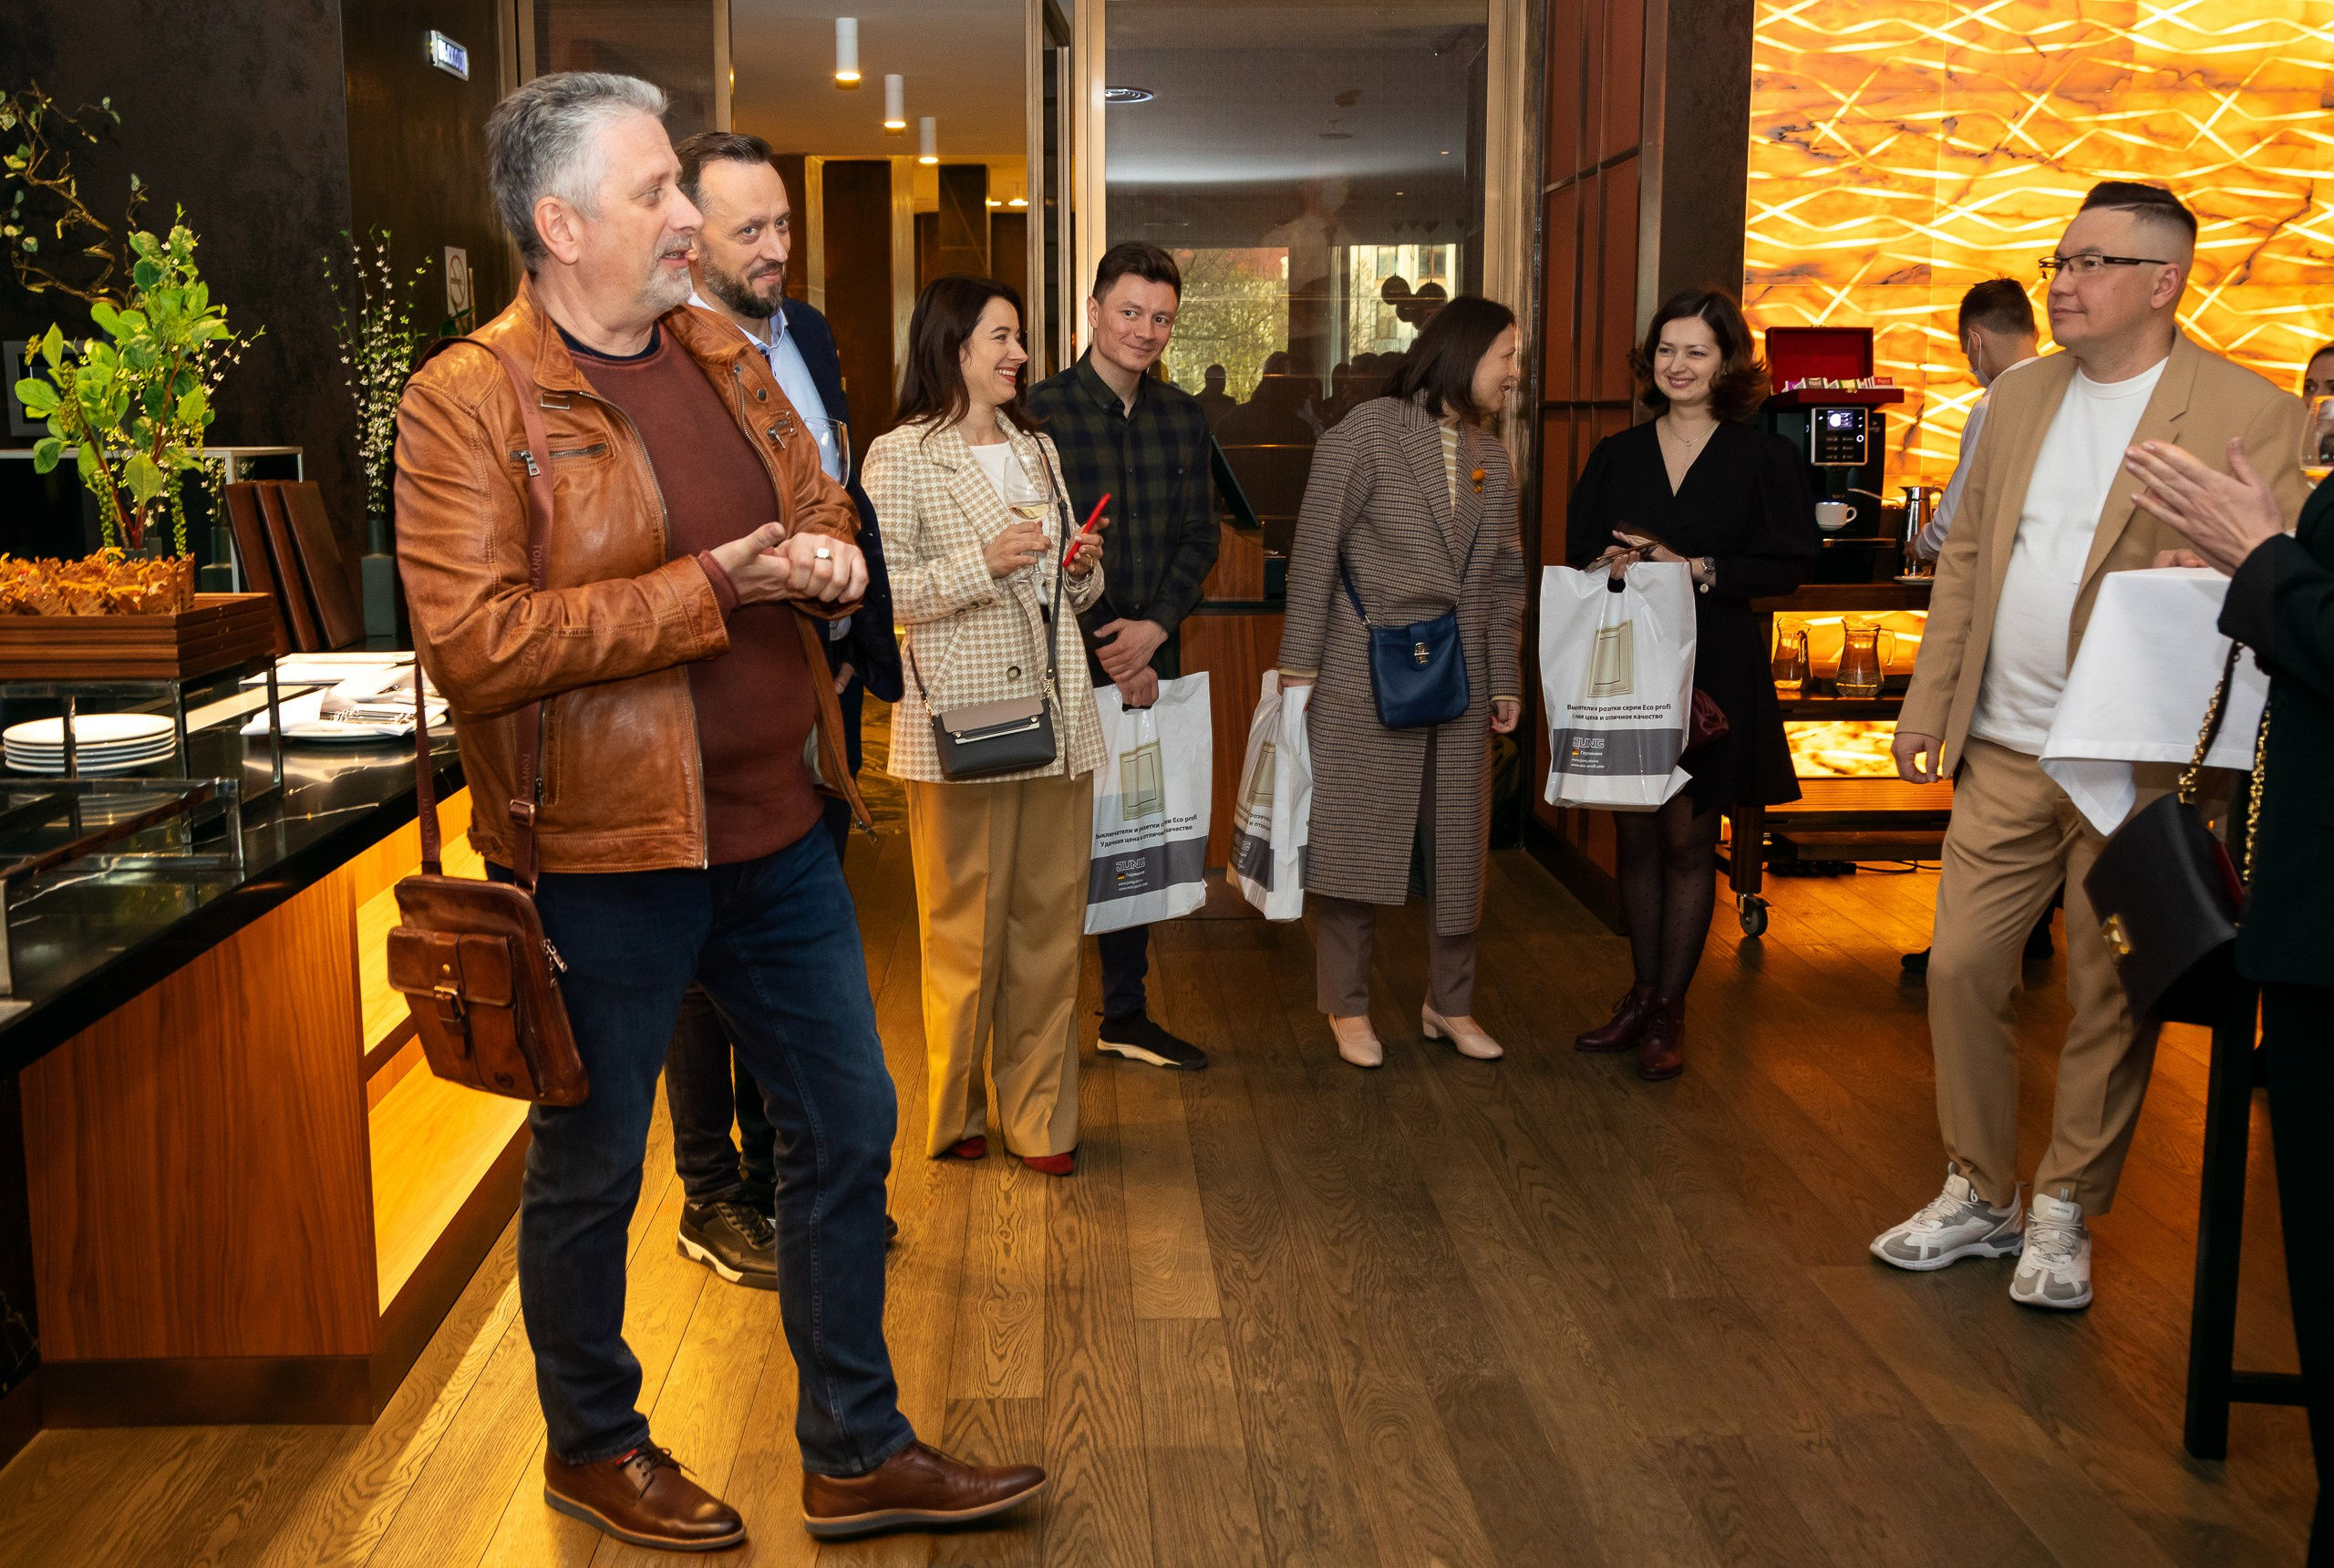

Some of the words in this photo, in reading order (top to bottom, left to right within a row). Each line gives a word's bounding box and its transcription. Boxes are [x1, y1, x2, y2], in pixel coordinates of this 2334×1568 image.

[532, 544, 543, 575] TONY
[1573, 737, 1605, 748] JUNG
[1184, 814, 1197, 823] profi
[1100, 839, 1124, 848] Удачная
[1142, 830, 1165, 840] отличн
[1116, 857, 1146, 872] JUNG
